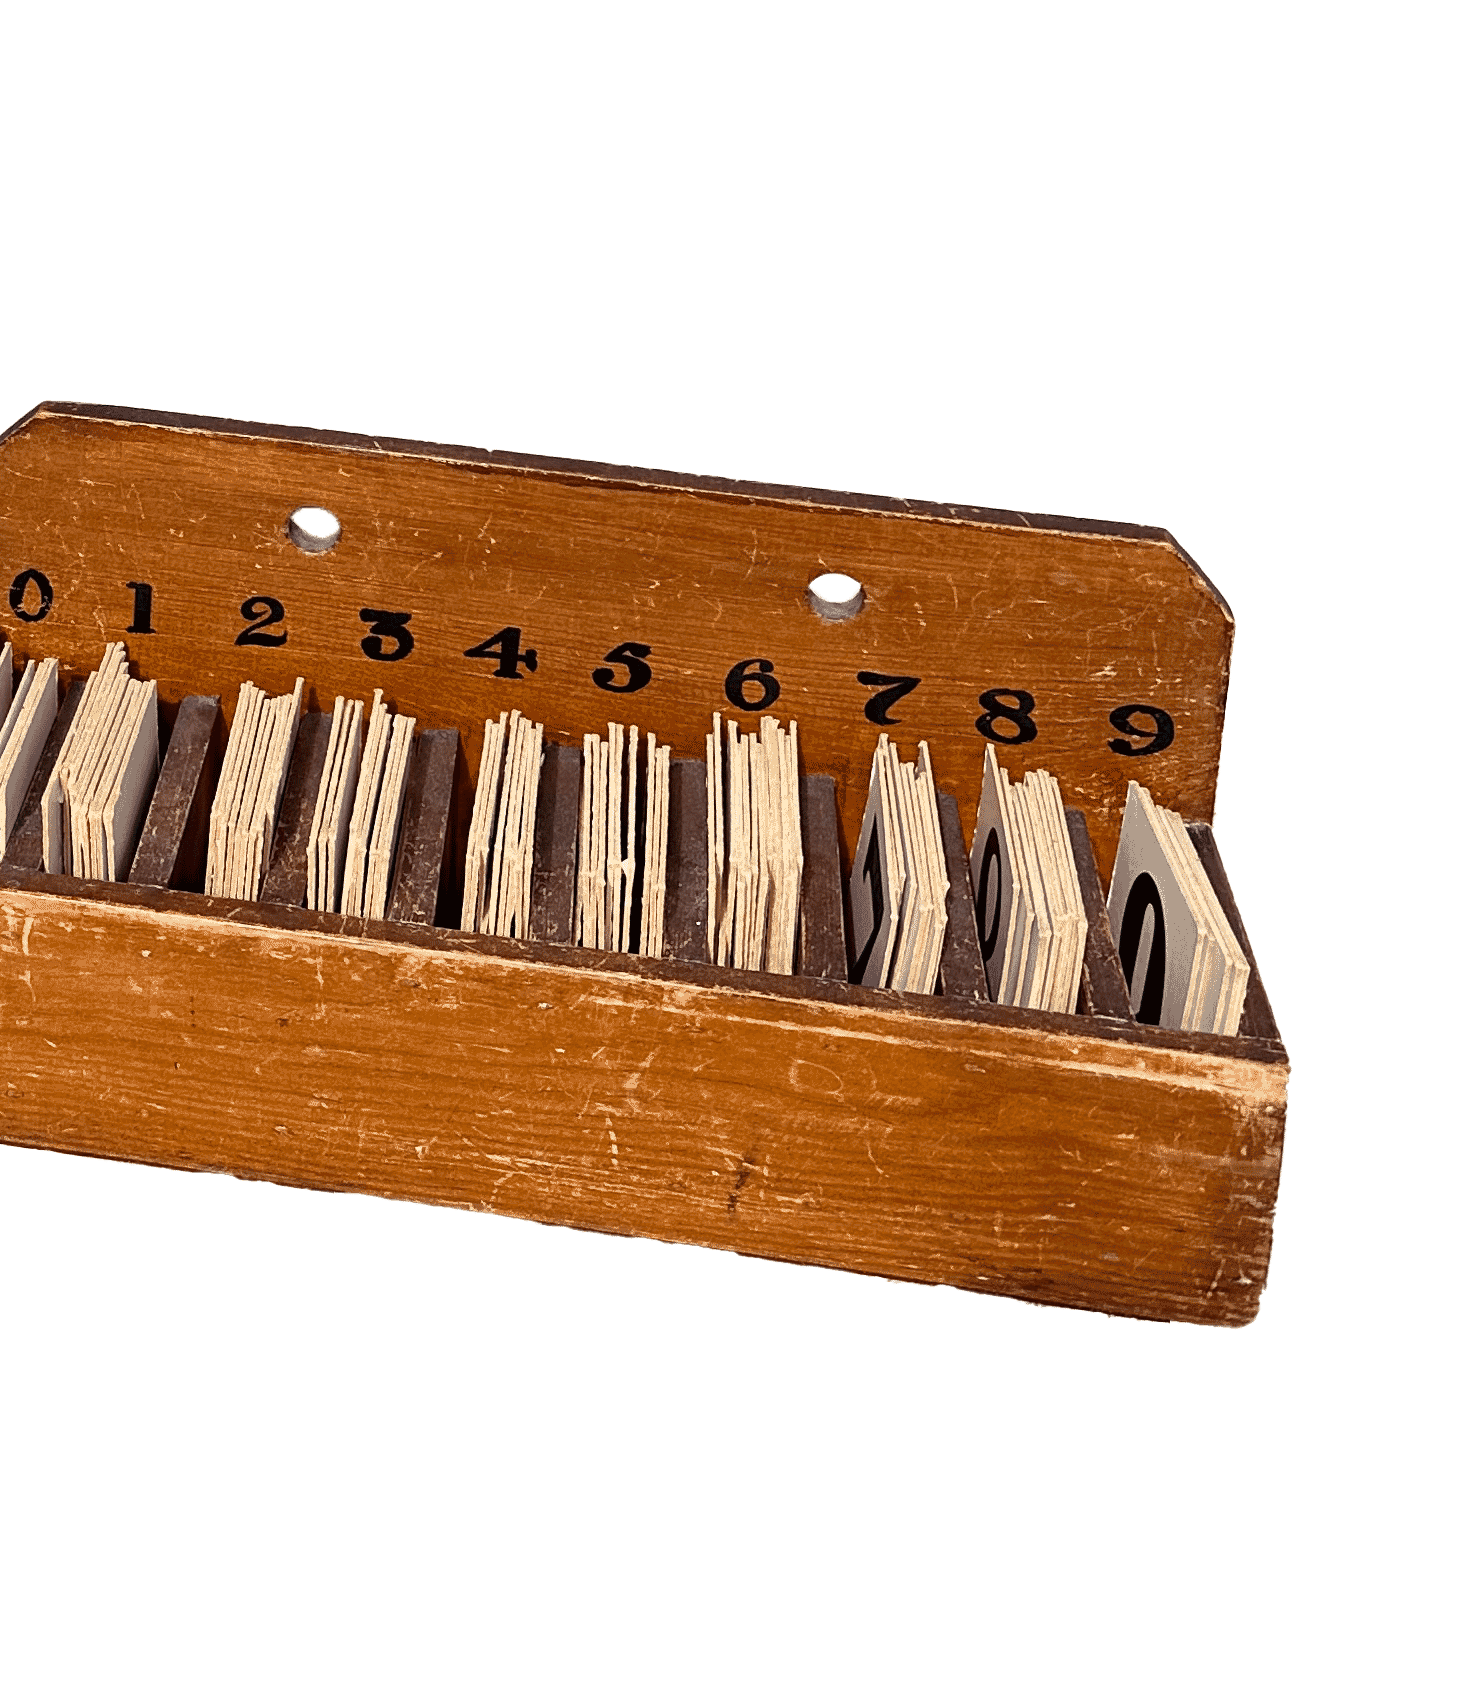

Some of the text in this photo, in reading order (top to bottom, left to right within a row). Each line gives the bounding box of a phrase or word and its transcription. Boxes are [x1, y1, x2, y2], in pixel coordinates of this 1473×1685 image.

[9, 568, 1175, 757] 0 1 2 3 4 5 6 7 8 9
